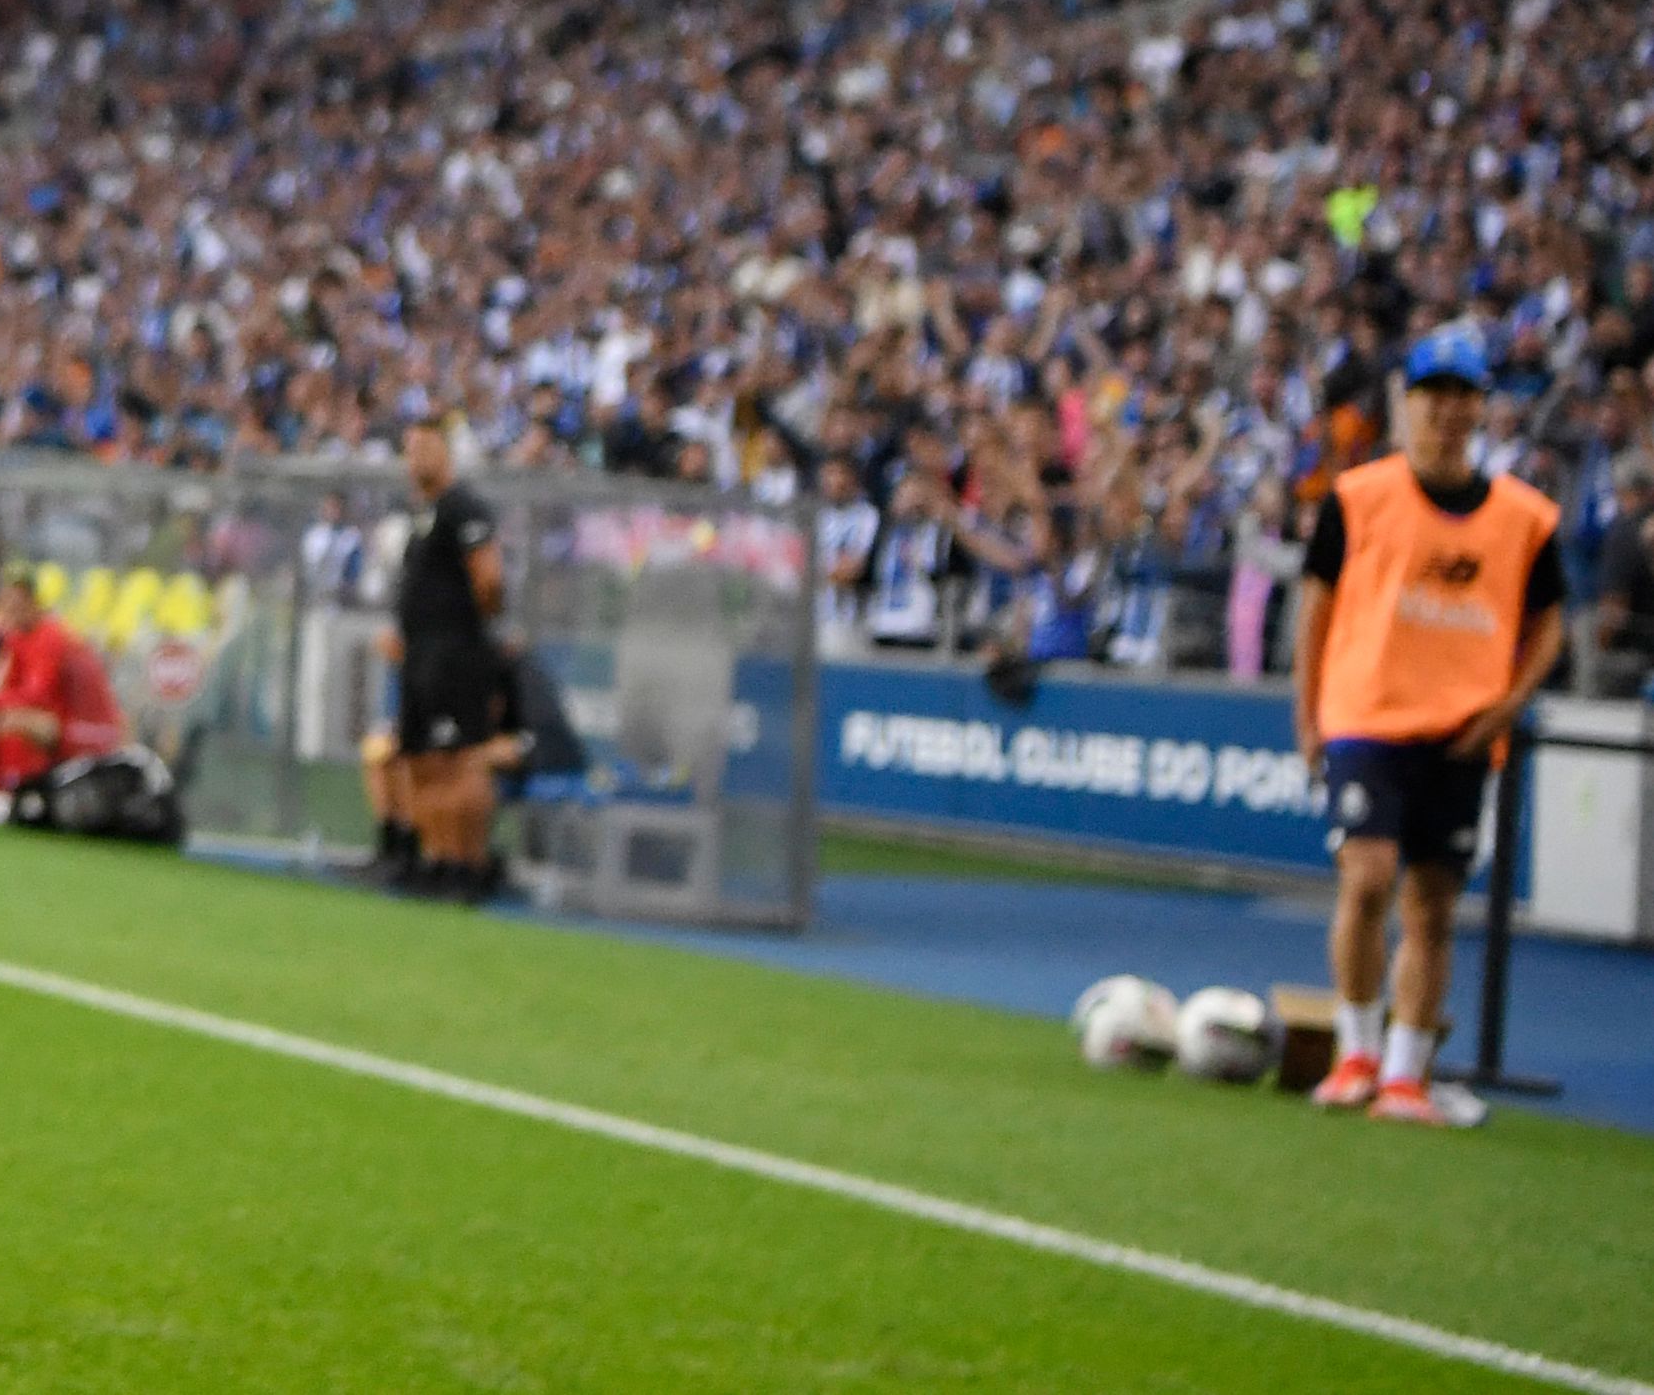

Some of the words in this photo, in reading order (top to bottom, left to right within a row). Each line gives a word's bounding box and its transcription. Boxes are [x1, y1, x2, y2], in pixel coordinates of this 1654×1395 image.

[842, 710, 1005, 782] FUTEBOL
[1010, 725, 1142, 797] CLUBE
[1147, 738, 1211, 804] DO
